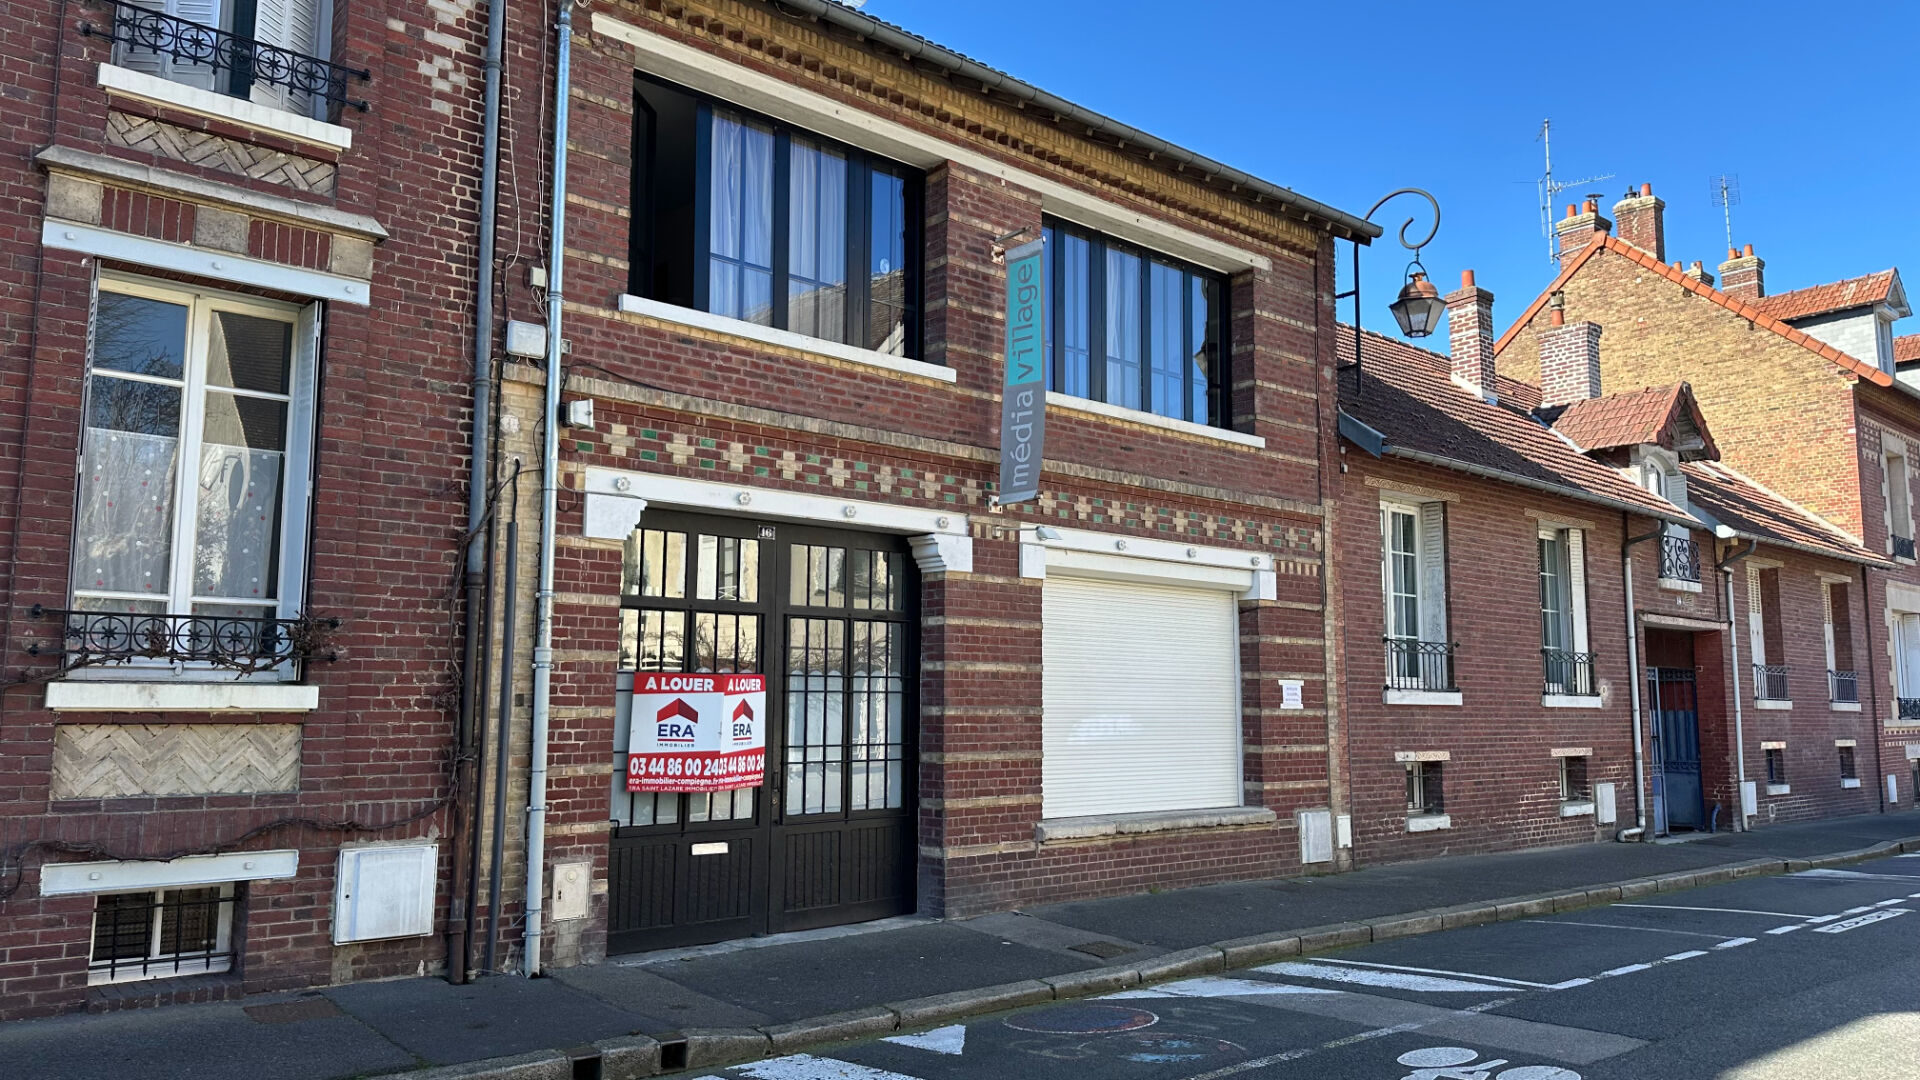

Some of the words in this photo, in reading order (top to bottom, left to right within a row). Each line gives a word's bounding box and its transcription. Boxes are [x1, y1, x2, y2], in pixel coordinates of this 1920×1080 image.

[1012, 263, 1038, 381] village
[1010, 389, 1034, 487] média
[761, 527, 772, 538] 16
[645, 676, 657, 690] A
[660, 677, 714, 692] LOUER
[727, 678, 734, 691] A
[735, 678, 761, 691] LOUER
[657, 724, 695, 737] ERA
[733, 723, 752, 736] ERA
[630, 757, 647, 776] 03
[648, 757, 665, 776] 44
[667, 757, 682, 776] 86
[685, 757, 702, 776] 00
[703, 758, 719, 776] 24
[719, 757, 728, 775] 03
[728, 756, 737, 774] 44
[737, 755, 746, 773] 86
[747, 754, 756, 772] 00
[756, 753, 765, 771] 24
